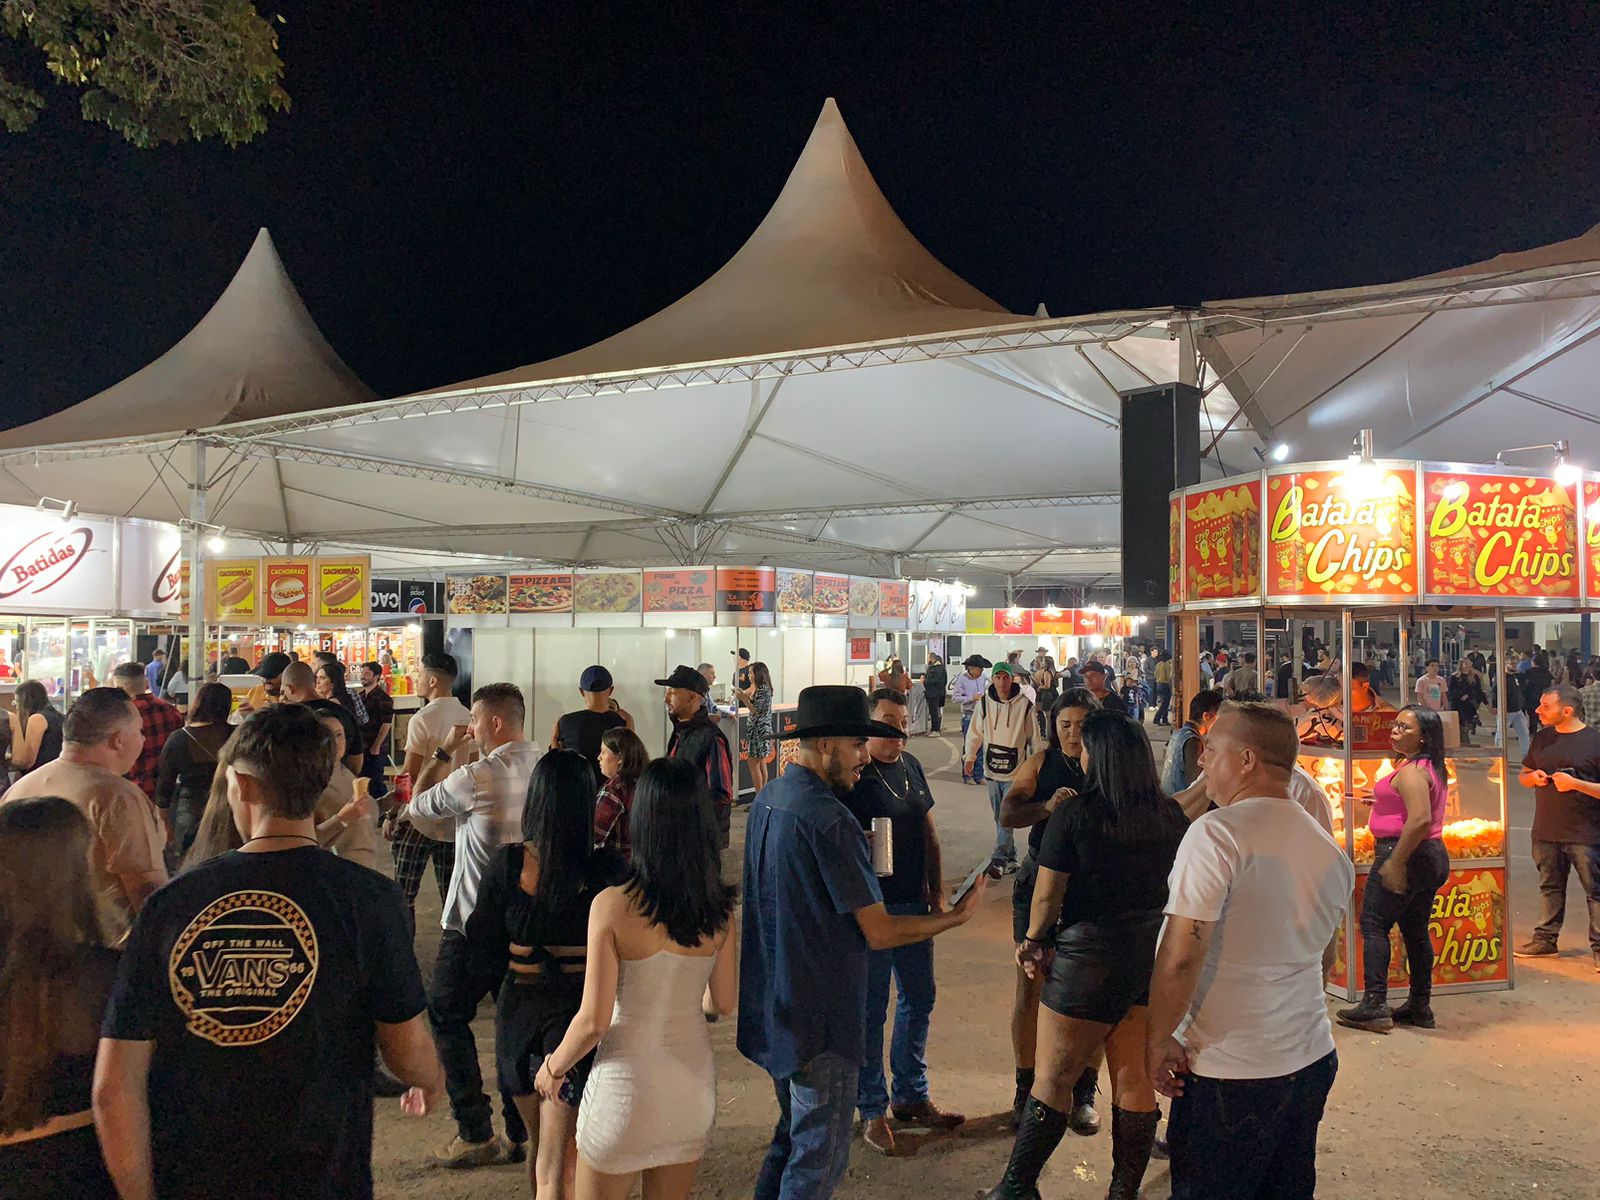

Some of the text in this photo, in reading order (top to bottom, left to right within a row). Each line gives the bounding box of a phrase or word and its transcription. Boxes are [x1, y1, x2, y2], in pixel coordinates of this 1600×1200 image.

[1271, 486, 1377, 541] Batata
[1430, 481, 1542, 538] Batata
[11, 544, 76, 584] Batidas
[1306, 528, 1406, 583] Chips
[1475, 530, 1573, 586] Chips
[525, 577, 557, 585] PIZZA
[669, 586, 704, 595] PIZZA
[852, 641, 870, 654] CAIXA
[202, 939, 285, 949] OFF THE WALL
[192, 948, 294, 989] VANS
[199, 987, 279, 998] THE ORIGINAL
